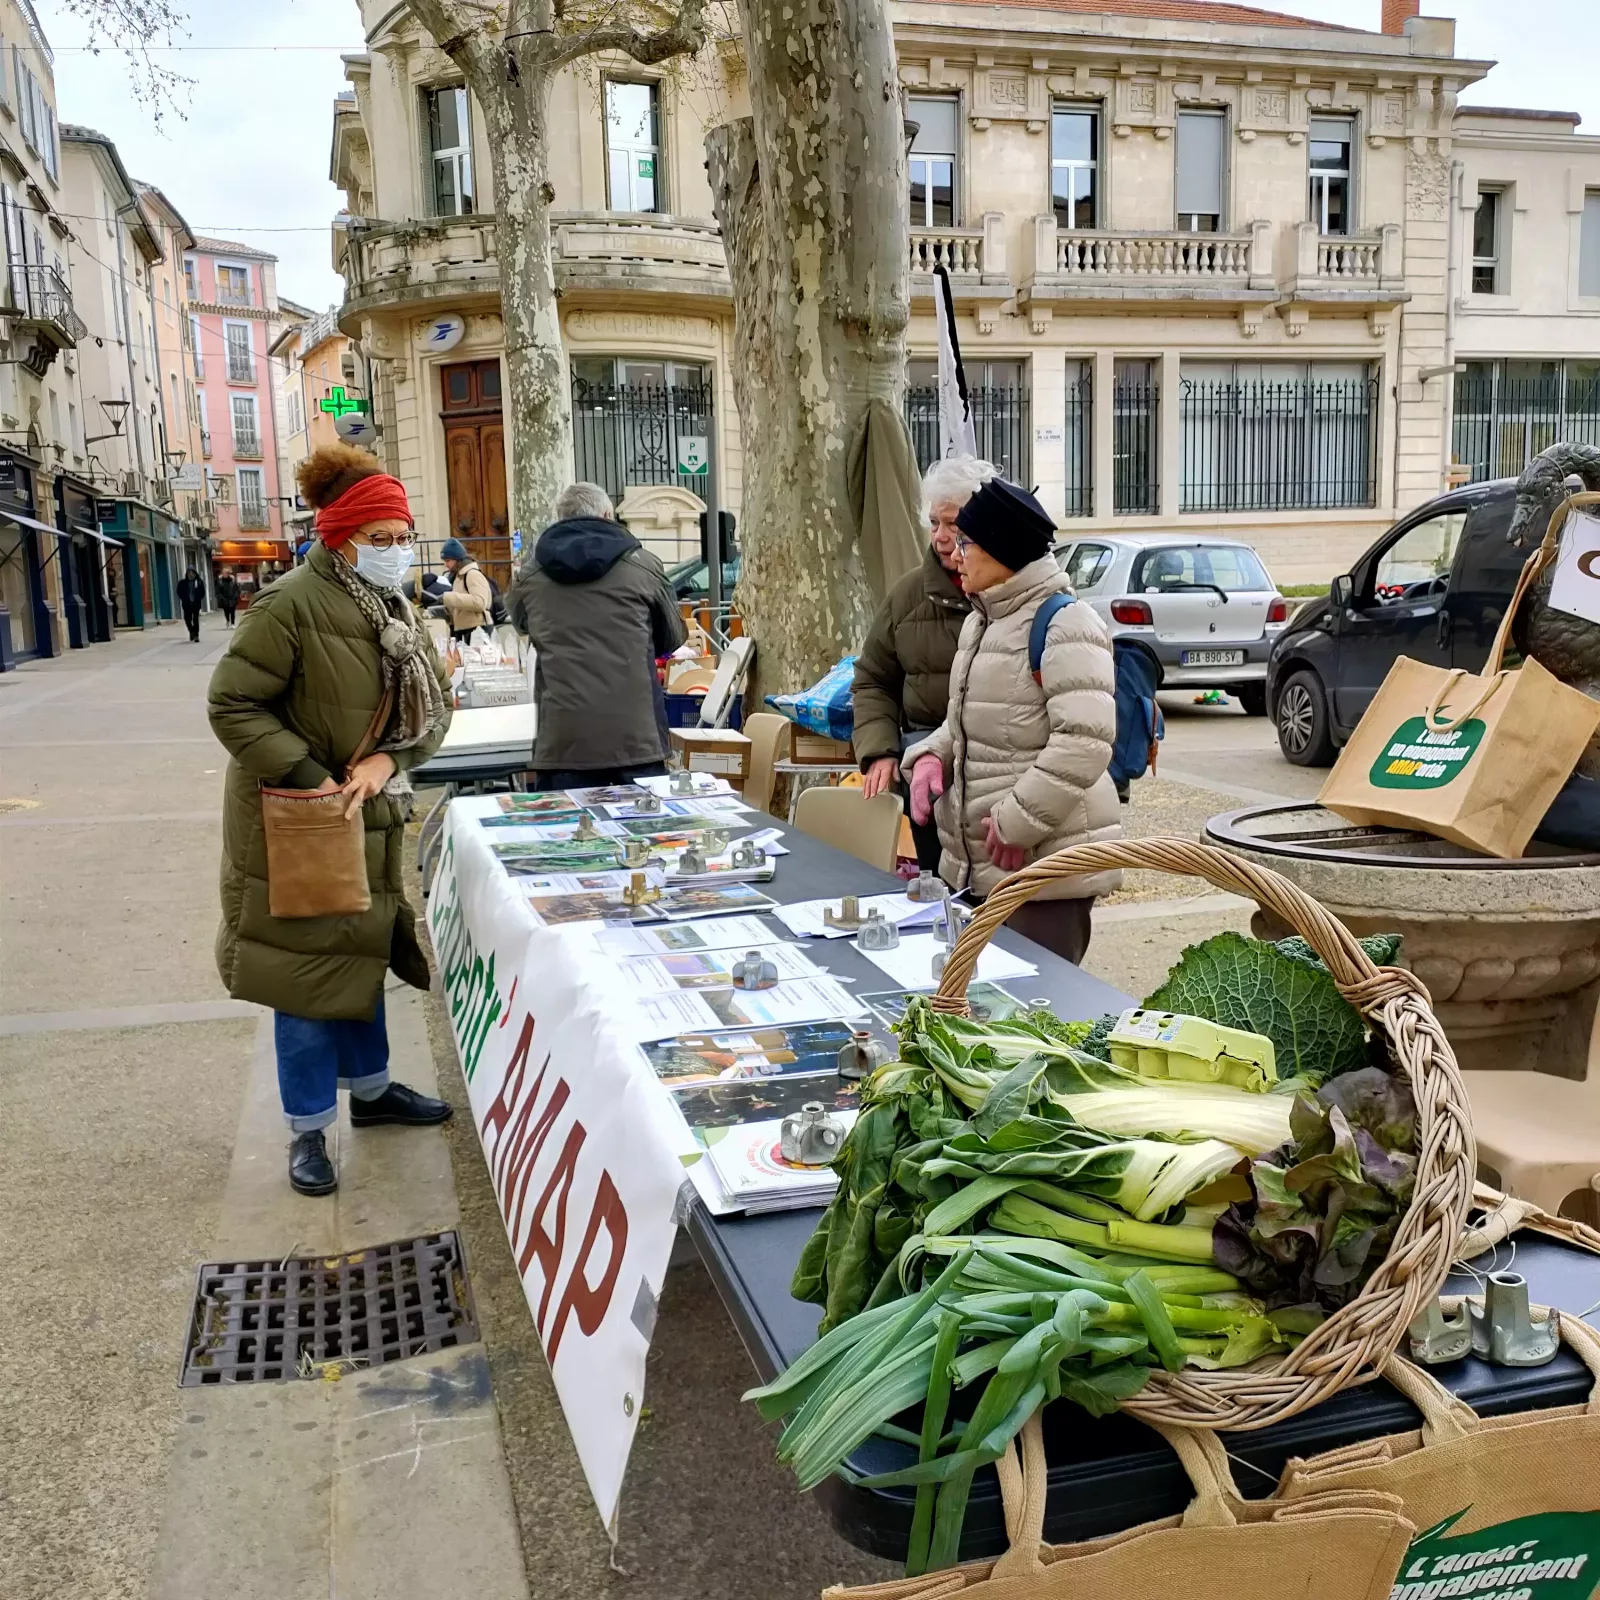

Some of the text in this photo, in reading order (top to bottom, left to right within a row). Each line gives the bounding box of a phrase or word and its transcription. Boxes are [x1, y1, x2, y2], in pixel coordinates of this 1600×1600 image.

[593, 316, 706, 340] CARPENTRA
[689, 442, 696, 451] P
[1189, 651, 1237, 664] BA-890-SV
[1387, 743, 1470, 761] un engagement
